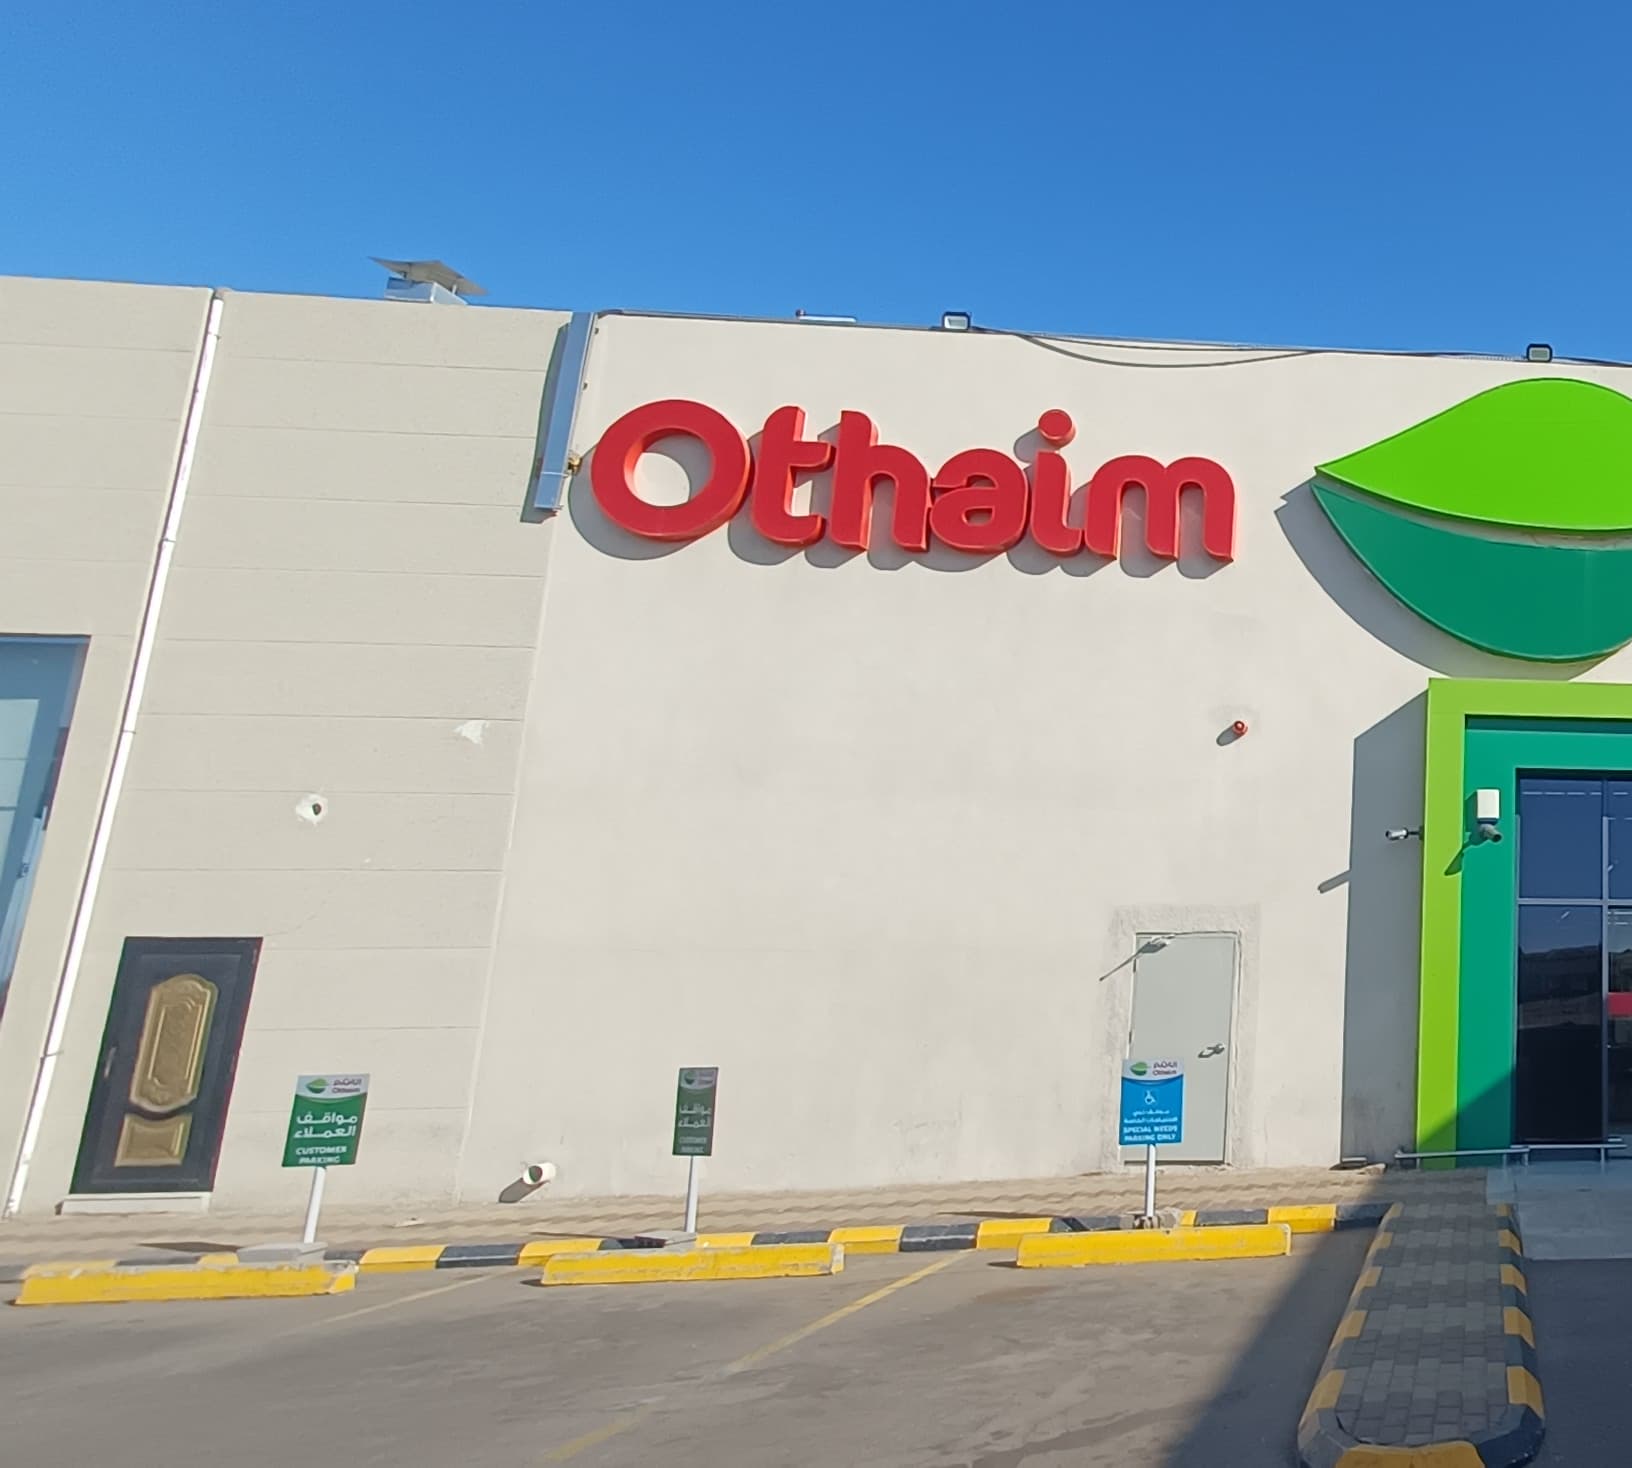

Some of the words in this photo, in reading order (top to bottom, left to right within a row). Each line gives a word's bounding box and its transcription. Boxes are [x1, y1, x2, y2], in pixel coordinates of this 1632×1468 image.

[590, 398, 1238, 565] Othaim
[296, 1112, 358, 1125] مواقف
[294, 1125, 356, 1138] العملاء
[295, 1145, 347, 1155] CUSTOMER
